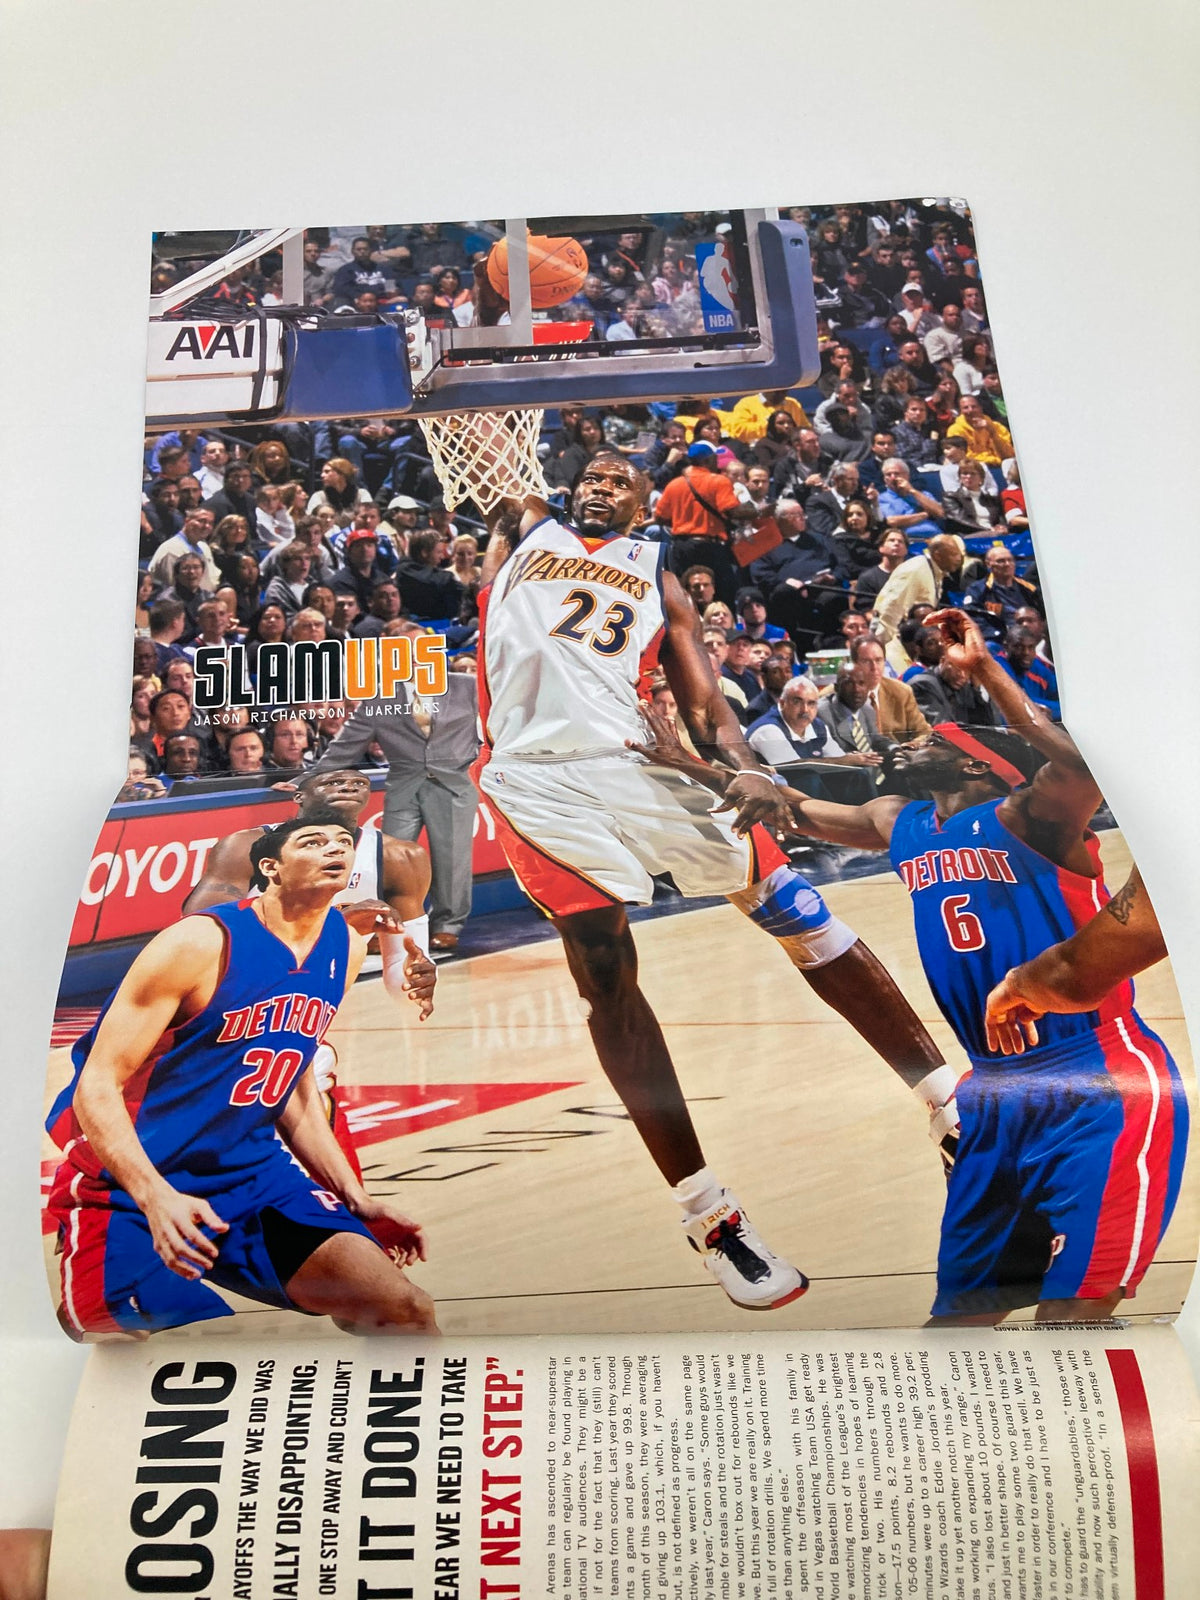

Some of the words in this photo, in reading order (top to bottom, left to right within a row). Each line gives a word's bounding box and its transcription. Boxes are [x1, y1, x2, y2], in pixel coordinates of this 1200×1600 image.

[709, 313, 735, 328] NBA
[501, 549, 654, 602] WARRIORS
[549, 588, 637, 657] 23
[194, 713, 241, 727] JASON
[250, 708, 356, 723] RICHARDSON,
[365, 702, 440, 717] WARRIORS
[899, 847, 1018, 894] DETROIT
[940, 893, 986, 953] 6
[229, 1047, 304, 1108] 20
[708, 1203, 731, 1224] RICH
[562, 1357, 572, 1366] in
[592, 1356, 602, 1382] can't
[606, 1356, 617, 1391] scored
[726, 1354, 735, 1369] we
[785, 1354, 794, 1363] in
[815, 1353, 825, 1374] was
[844, 1352, 858, 1394] learning
[859, 1352, 869, 1370] the
[889, 1352, 902, 1382] more.
[948, 1352, 961, 1382] Caron
[993, 1351, 1008, 1376] year,
[1082, 1350, 1093, 1367] the
[253, 1360, 275, 1393] WAS
[441, 1357, 467, 1406] TAKE
[561, 1370, 574, 1408] playing
[651, 1356, 662, 1393] haven't
[726, 1372, 737, 1391] like
[786, 1368, 798, 1401] family
[817, 1379, 828, 1394] He
[918, 1351, 936, 1398] prodding
[1087, 1371, 1102, 1405] sense
[330, 1360, 353, 1426] COULDN'T
[548, 1357, 559, 1435] near-superstar
[591, 1387, 604, 1414] (still)
[607, 1393, 619, 1417] they
[848, 1399, 860, 1411] of
[861, 1376, 876, 1420] through
[893, 1384, 904, 1399] do
[998, 1379, 1010, 1401] this
[249, 1398, 269, 1423] DID
[482, 1357, 524, 1458] STEP."
[654, 1399, 665, 1419] you
[791, 1408, 800, 1425] his
[896, 1402, 906, 1414] to
[1001, 1404, 1018, 1437] guard
[362, 1357, 425, 1498] DONE.
[439, 1413, 464, 1440] TO
[561, 1413, 572, 1446] found
[592, 1420, 604, 1445] they
[609, 1419, 619, 1445] year
[653, 1424, 663, 1432] if
[728, 1396, 740, 1450] rebounds
[852, 1416, 864, 1452] hopes
[898, 1417, 909, 1452] wants
[245, 1428, 265, 1455] WE
[276, 1360, 318, 1534] DISAPPOINTING.
[327, 1432, 345, 1463] AND
[547, 1441, 556, 1453] to
[792, 1432, 802, 1457] with
[820, 1401, 836, 1496] Championships.
[869, 1428, 882, 1482] numbers
[962, 1432, 972, 1450] my
[1009, 1441, 1019, 1463] two
[562, 1452, 571, 1467] be
[592, 1450, 602, 1475] that
[608, 1447, 618, 1473] Last
[654, 1439, 665, 1477] which,
[731, 1454, 742, 1471] for
[856, 1458, 865, 1469] in
[902, 1456, 912, 1471] he
[125, 1361, 237, 1600] OSING
[240, 1459, 260, 1496] WAY
[437, 1446, 462, 1504] NEED
[546, 1459, 556, 1518] ascended
[733, 1476, 743, 1496] out
[903, 1474, 914, 1494] but
[933, 1461, 945, 1494] Eddie
[963, 1454, 978, 1515] expanding
[1012, 1466, 1022, 1499] some
[1100, 1448, 1117, 1530] defense-proof.
[323, 1469, 342, 1514] AWAY
[561, 1472, 574, 1524] regularly
[593, 1481, 603, 1505] fact
[608, 1477, 620, 1525] scoring.
[654, 1484, 666, 1524] 103.1,
[795, 1464, 806, 1526] offseason
[873, 1490, 883, 1510] His
[237, 1502, 257, 1533] THE
[480, 1470, 521, 1566] NEXT
[593, 1511, 603, 1531] the
[734, 1501, 744, 1522] box
[857, 1475, 870, 1541] tendencies
[935, 1501, 947, 1537] coach
[1014, 1503, 1026, 1527] play
[321, 1519, 339, 1559] STOP
[359, 1516, 415, 1561] IT
[436, 1512, 461, 1550] WE
[546, 1524, 556, 1547] has
[563, 1530, 572, 1552] can
[658, 1531, 668, 1546] up
[827, 1503, 839, 1565] Basketball
[876, 1520, 885, 1544] two.
[906, 1498, 917, 1554] numbers,
[969, 1520, 978, 1535] on
[1016, 1530, 1025, 1543] to
[593, 1537, 603, 1554] for
[608, 1528, 619, 1556] from
[734, 1528, 745, 1577] wouldn't
[797, 1532, 807, 1552] the
[1017, 1547, 1026, 1564] me
[1108, 1535, 1119, 1578] virtually
[273, 1543, 300, 1600] ALLY
[562, 1558, 571, 1588] team
[594, 1561, 603, 1580] not
[656, 1552, 669, 1588] giving
[878, 1552, 886, 1565] or
[938, 1543, 949, 1589] Wizards
[970, 1539, 981, 1583] working
[319, 1564, 337, 1595] ONE
[546, 1553, 556, 1595] Arenas
[610, 1559, 619, 1597] teams
[799, 1560, 810, 1593] spent
[877, 1573, 887, 1599] trick
[1017, 1569, 1026, 1600] wants
[593, 1586, 603, 1594] if
[737, 1582, 745, 1598] we
